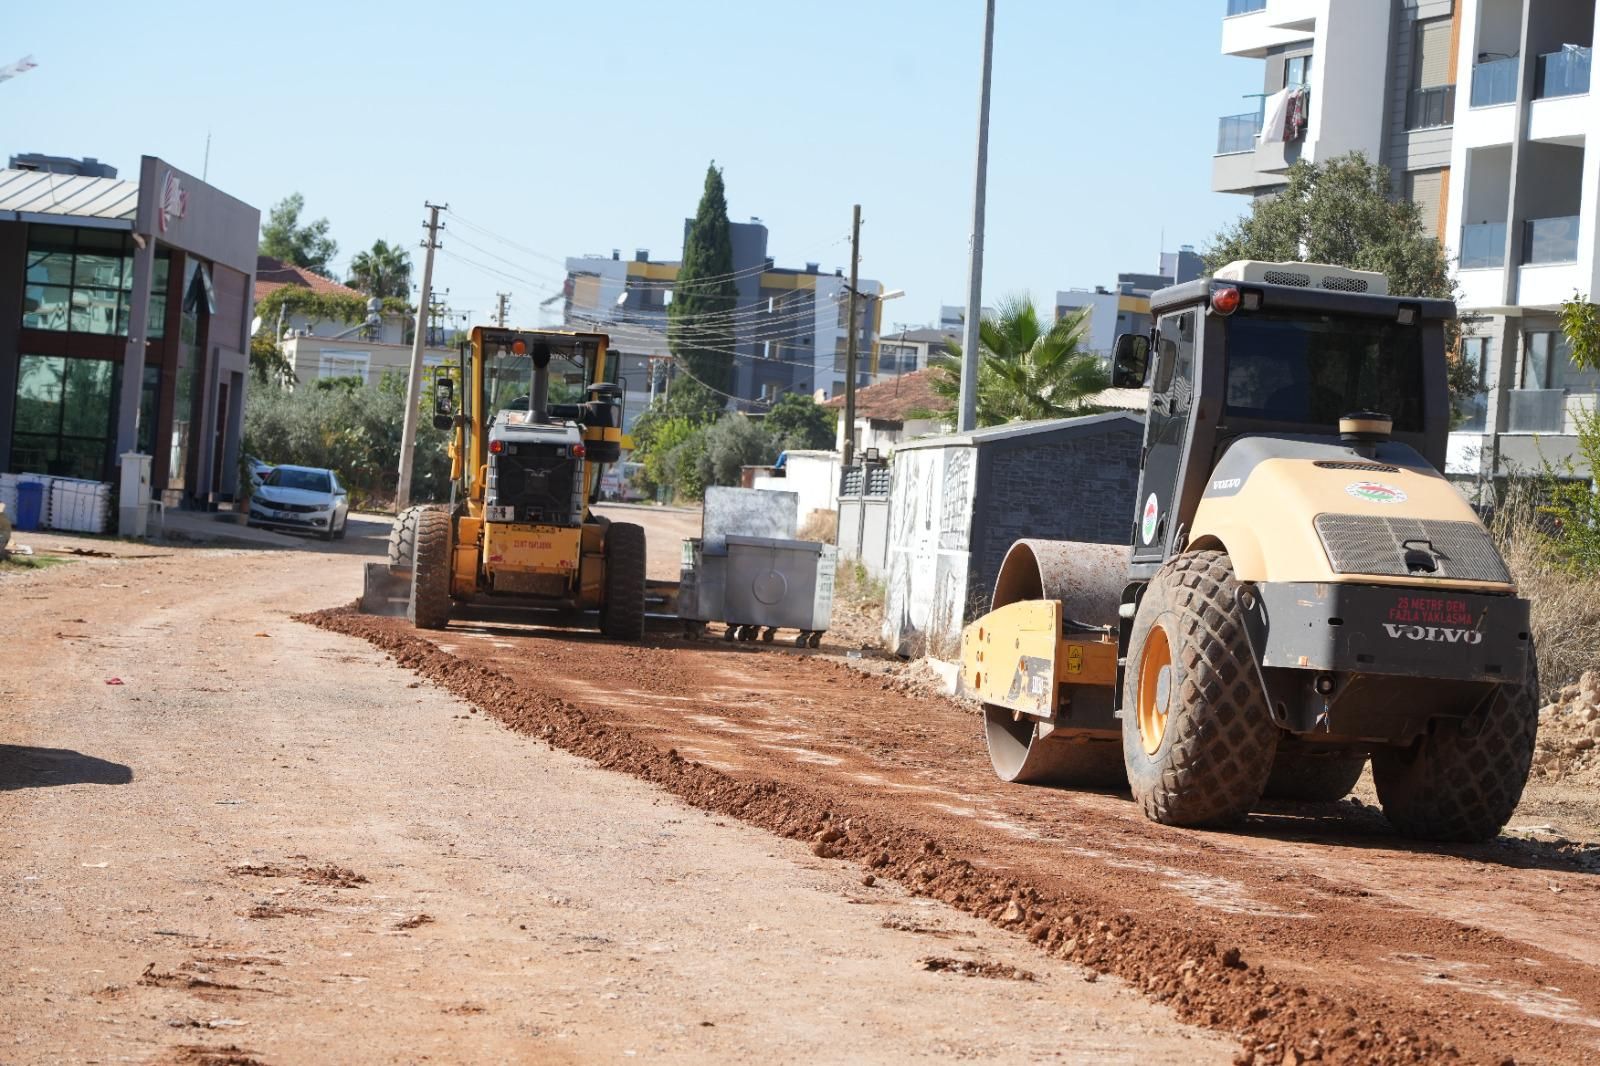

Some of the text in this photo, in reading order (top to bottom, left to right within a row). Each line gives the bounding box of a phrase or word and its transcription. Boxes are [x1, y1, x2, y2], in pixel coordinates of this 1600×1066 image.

[1213, 478, 1241, 490] VOLVO
[1389, 608, 1419, 621] FAZLA
[1382, 622, 1482, 645] VOLVO
